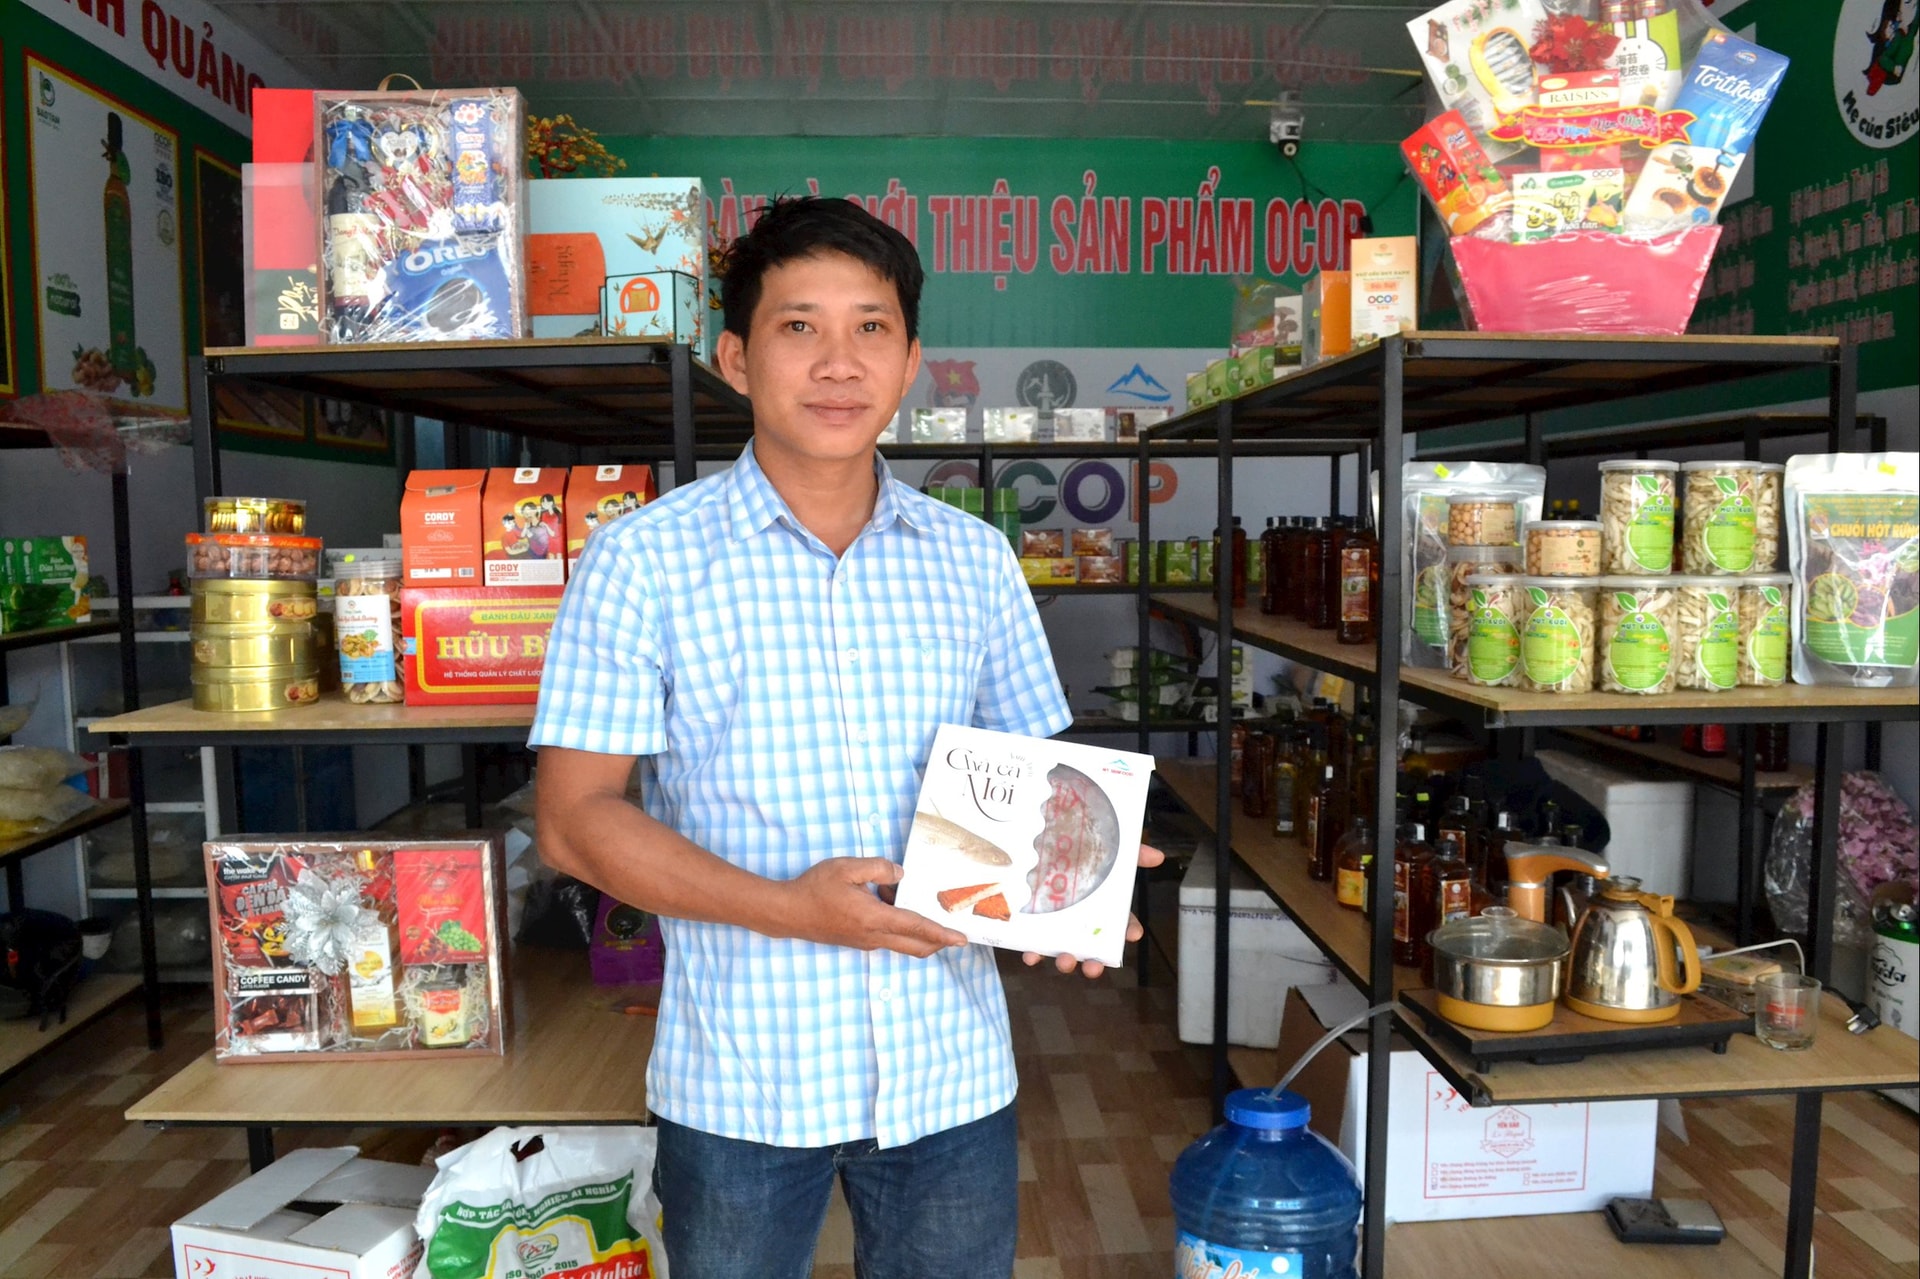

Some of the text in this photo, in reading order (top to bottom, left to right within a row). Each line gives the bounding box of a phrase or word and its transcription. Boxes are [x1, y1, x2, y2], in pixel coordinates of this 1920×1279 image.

[1550, 89, 1609, 103] RAISINS
[1592, 169, 1621, 179] OCOP
[928, 178, 1039, 291] THIỆU
[1050, 169, 1133, 275] SẢN
[1142, 165, 1255, 275] PHẨM
[1265, 197, 1368, 276] OCOP
[404, 244, 487, 273] OREO
[1367, 293, 1399, 305] OCOP
[424, 512, 455, 522] CORDY
[489, 563, 519, 572] CORDY
[436, 630, 511, 660] HỮU
[240, 974, 307, 985] COFFEE CANDY
[456, 1206, 476, 1220] HỢP
[479, 1207, 500, 1220] TÁC
[585, 1183, 618, 1196] NGHĨA
[554, 1260, 579, 1270] 2015
